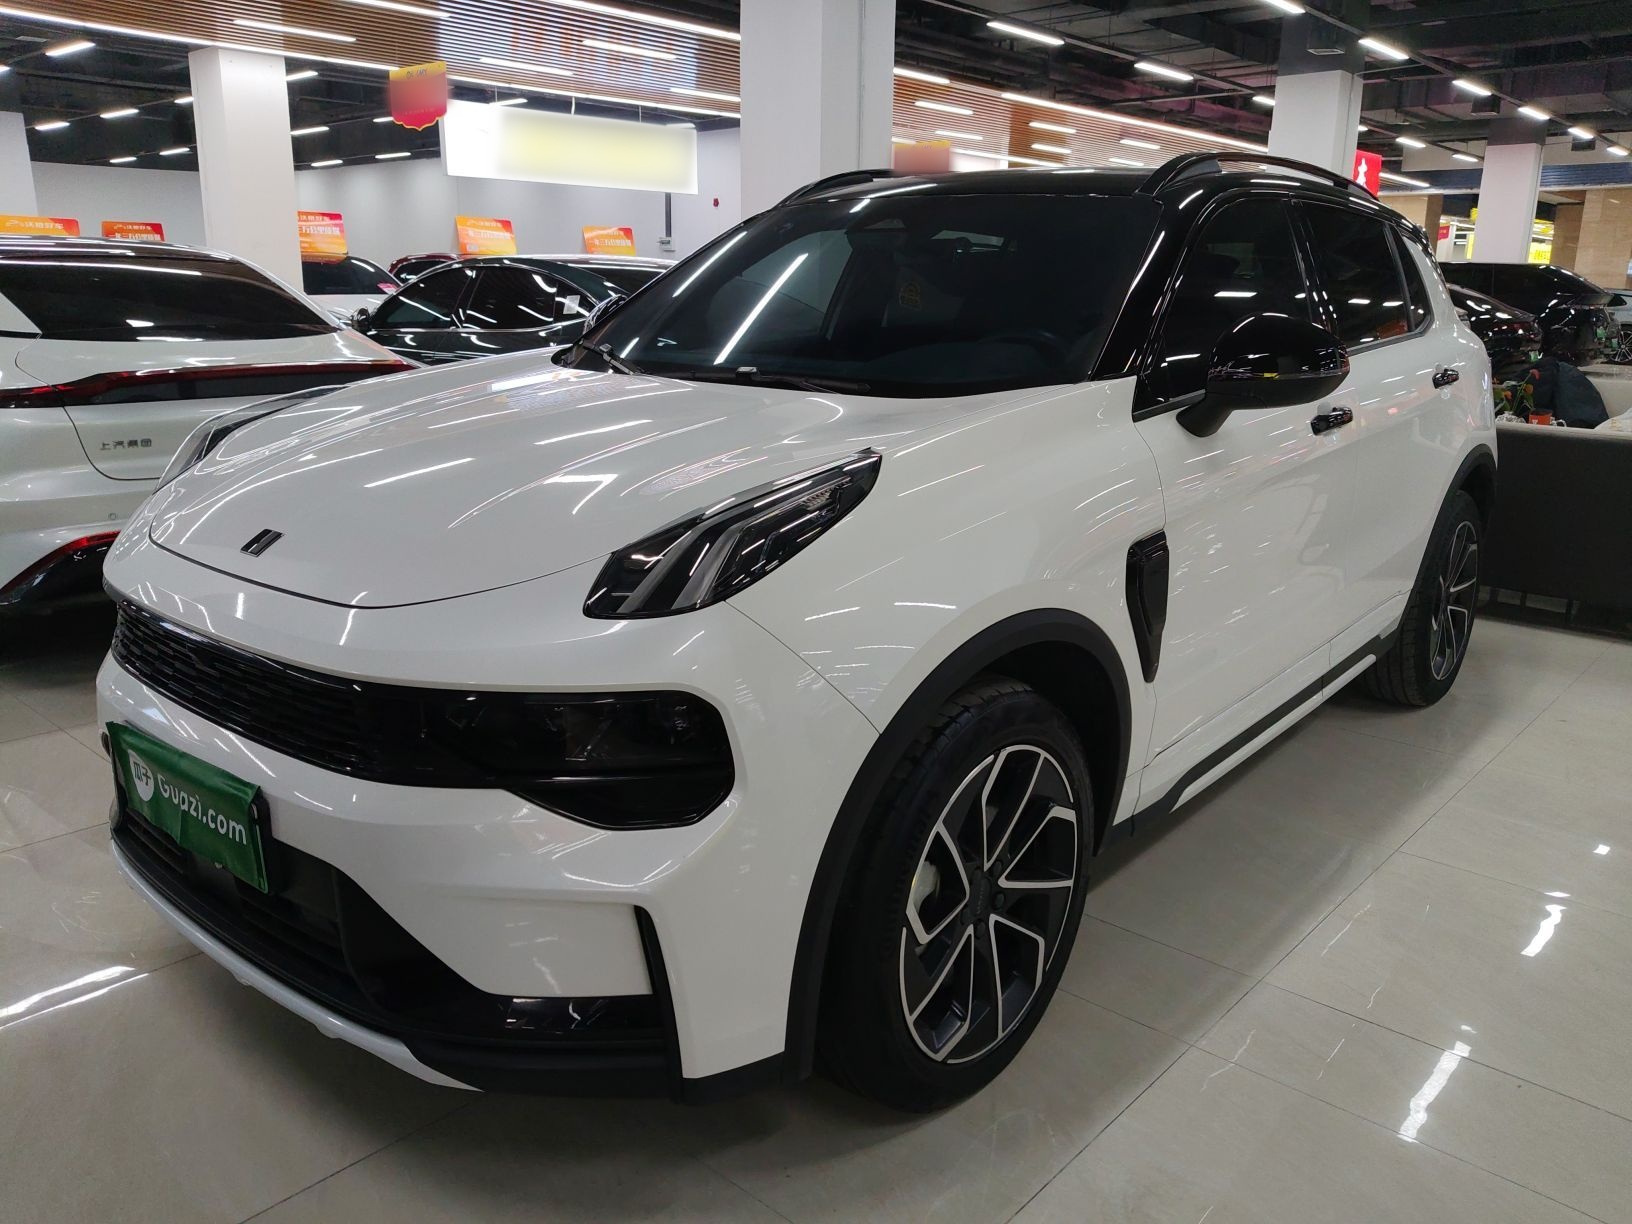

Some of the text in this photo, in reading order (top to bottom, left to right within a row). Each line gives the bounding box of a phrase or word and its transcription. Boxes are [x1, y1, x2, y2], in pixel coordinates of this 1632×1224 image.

[100, 438, 152, 450] 上汽集团
[133, 761, 152, 786] 瓜子
[157, 774, 247, 845] Guazi.com
